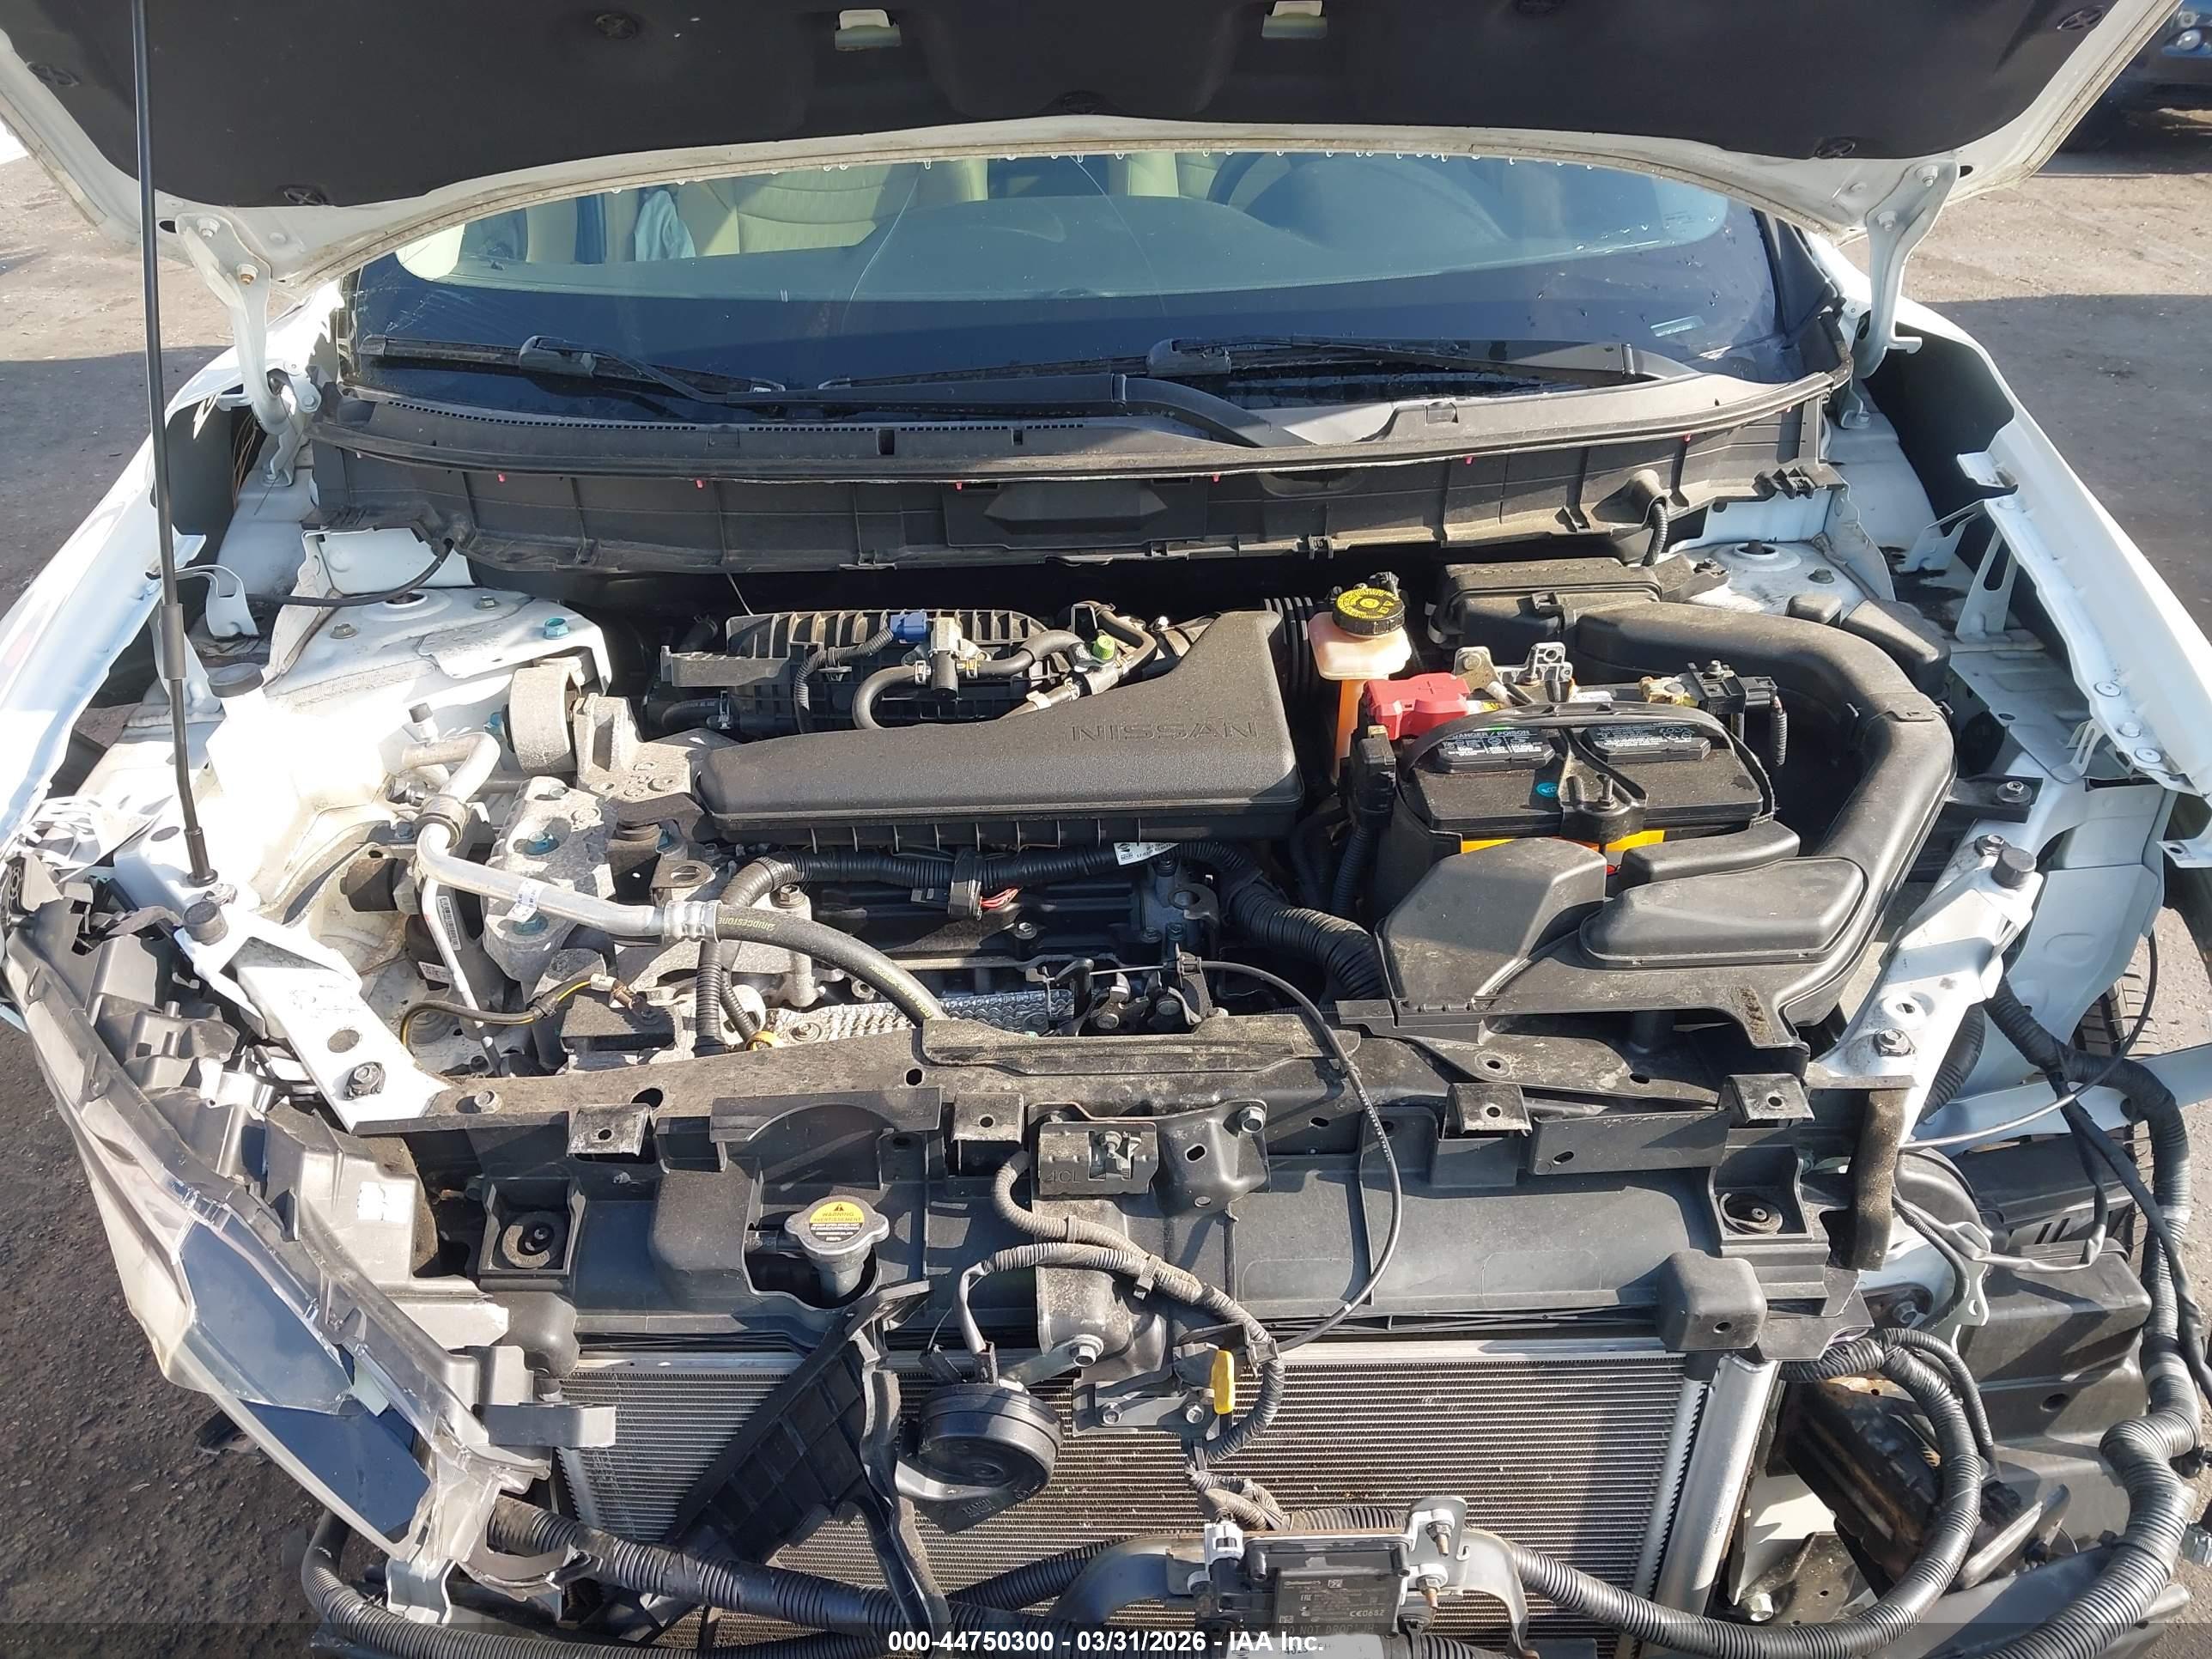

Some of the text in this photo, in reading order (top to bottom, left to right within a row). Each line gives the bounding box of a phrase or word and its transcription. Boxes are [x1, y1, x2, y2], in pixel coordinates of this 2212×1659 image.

[1066, 718, 1258, 742] NISSAN
[717, 916, 776, 932] BRIDGESTONE
[1299, 1625, 1321, 1635] NOT
